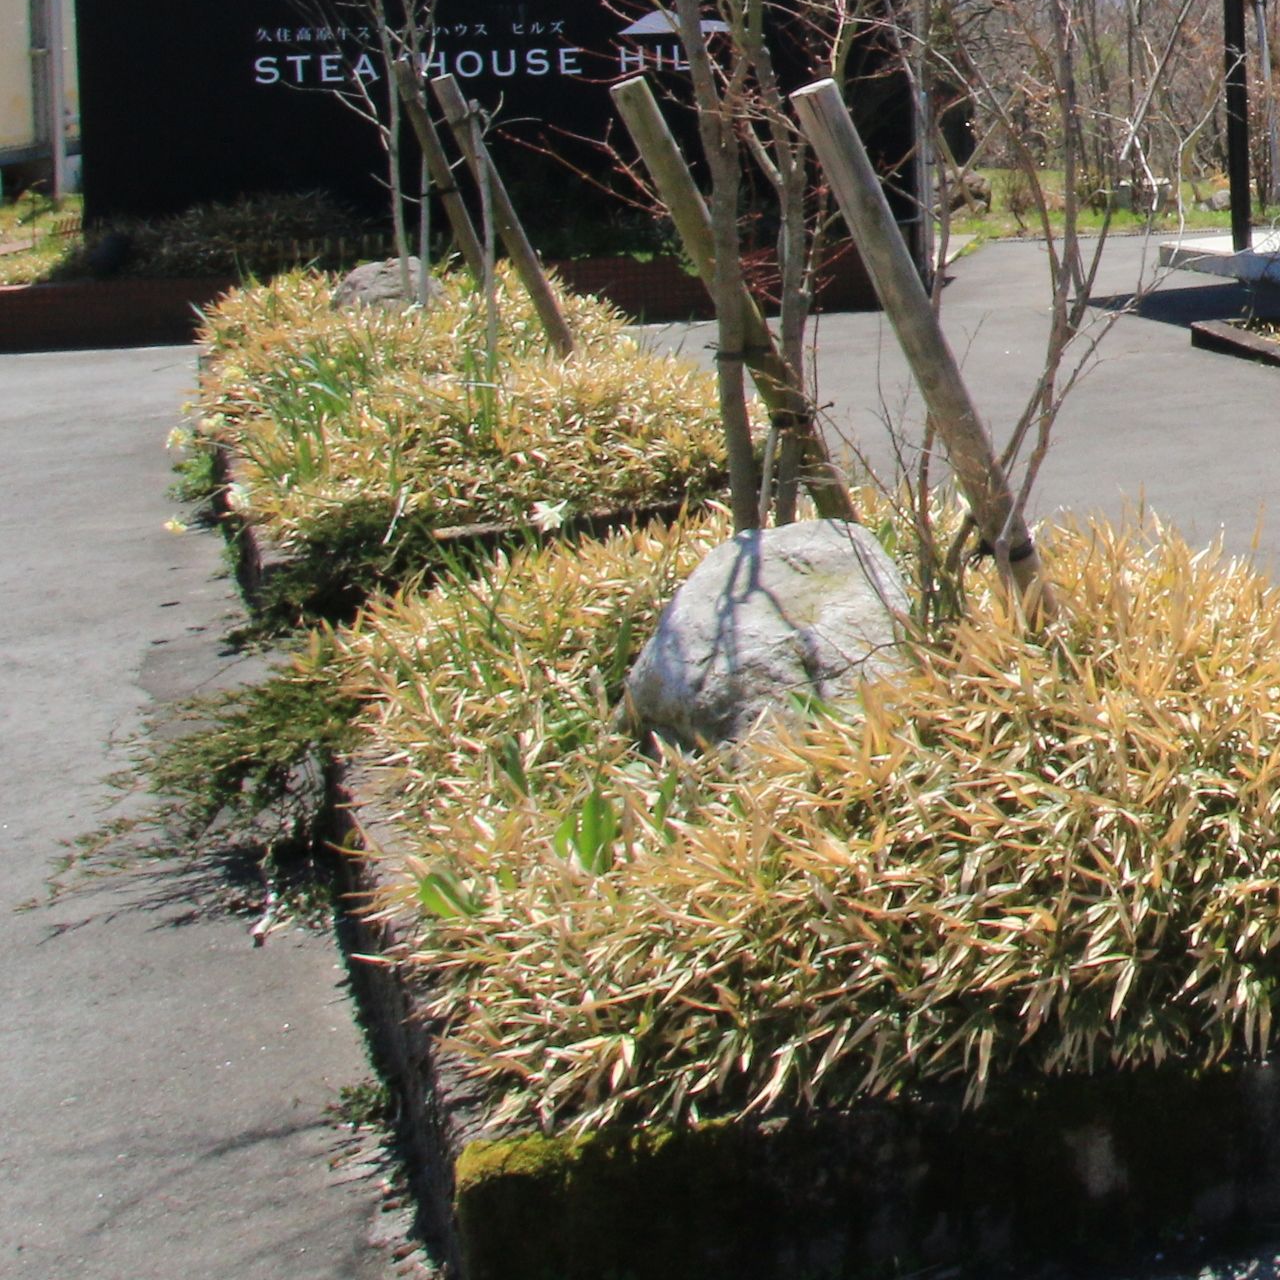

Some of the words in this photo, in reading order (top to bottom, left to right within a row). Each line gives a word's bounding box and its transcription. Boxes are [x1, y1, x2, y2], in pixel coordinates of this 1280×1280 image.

[512, 20, 566, 36] ヒルズ
[253, 46, 583, 84] STEAHOUSE
